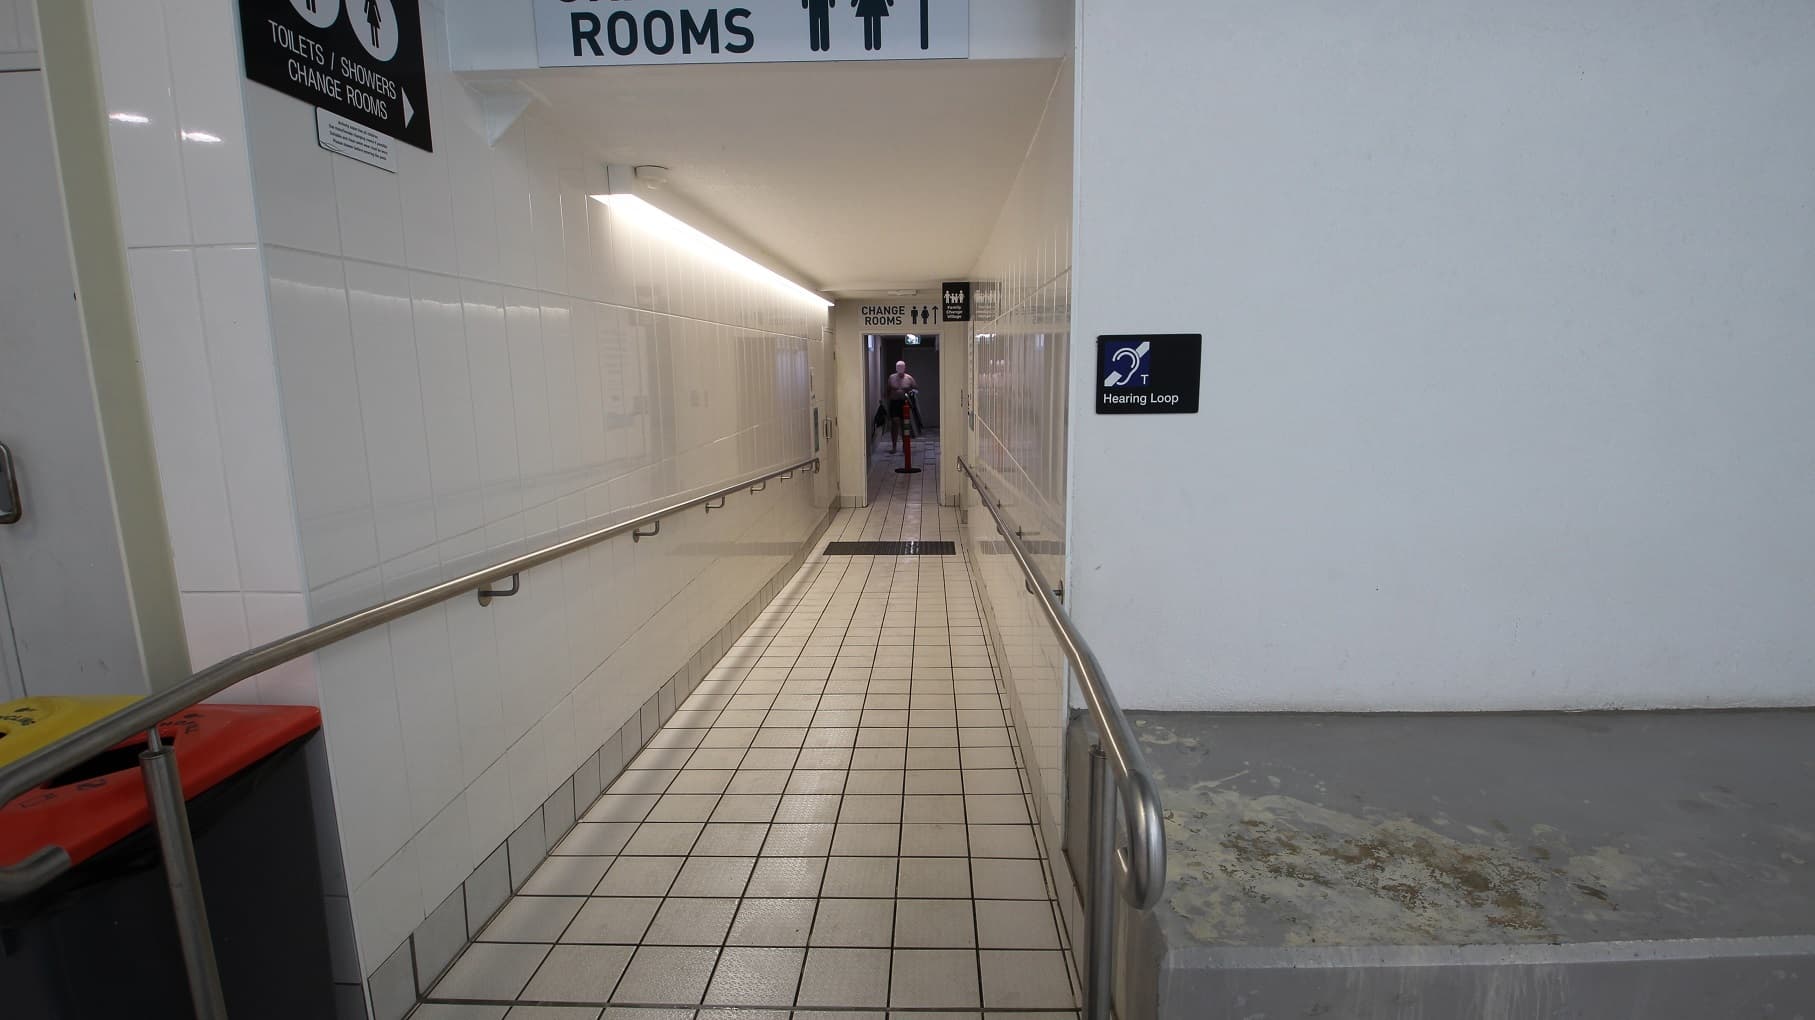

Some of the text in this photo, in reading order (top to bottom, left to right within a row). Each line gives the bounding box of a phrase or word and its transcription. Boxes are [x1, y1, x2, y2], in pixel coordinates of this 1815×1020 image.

[571, 7, 755, 57] ROOMS
[268, 19, 325, 66] TOILETS
[340, 56, 397, 100] SHOWERS
[288, 59, 389, 120] CHANGE ROOMS
[861, 305, 905, 315] CHANGE
[864, 316, 903, 326] ROOMS
[1140, 374, 1149, 384] T
[1103, 393, 1179, 406] Hearing Loop
